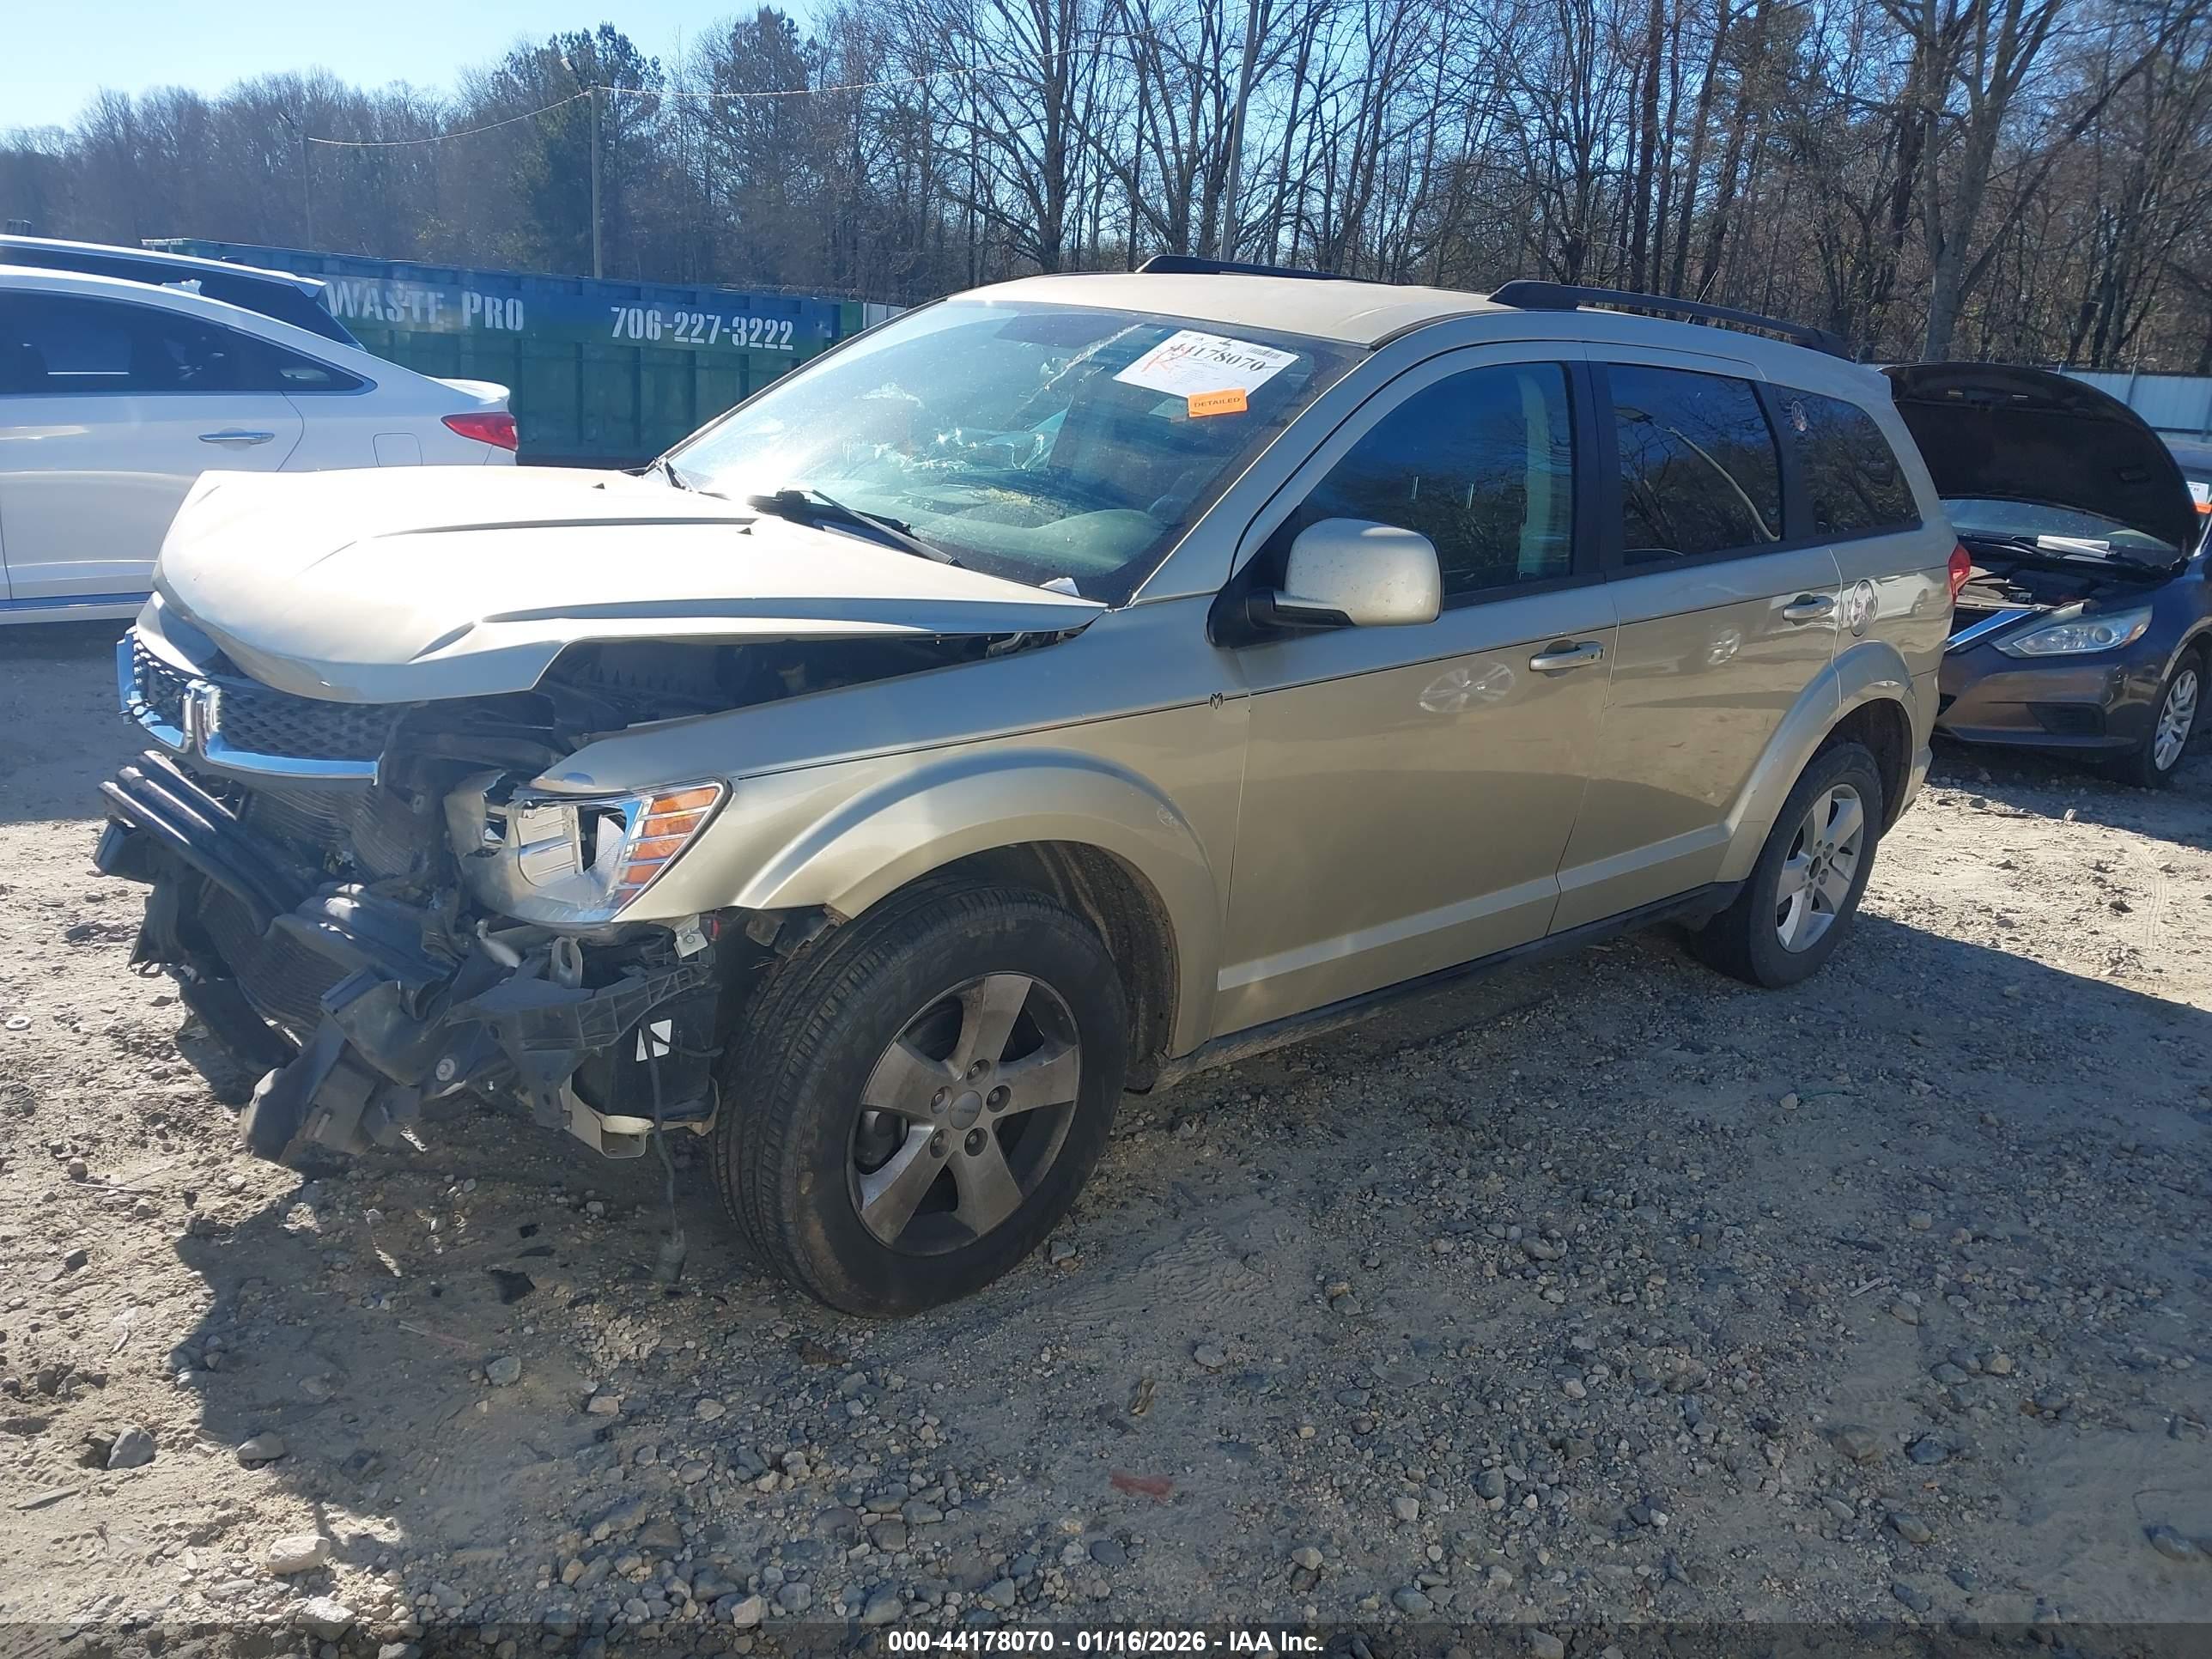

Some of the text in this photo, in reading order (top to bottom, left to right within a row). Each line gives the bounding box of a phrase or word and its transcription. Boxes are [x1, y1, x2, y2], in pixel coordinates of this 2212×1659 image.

[325, 281, 524, 331] WASTE PRO
[611, 307, 793, 350] 706-227-3222
[1194, 396, 1241, 408] DETAILED
